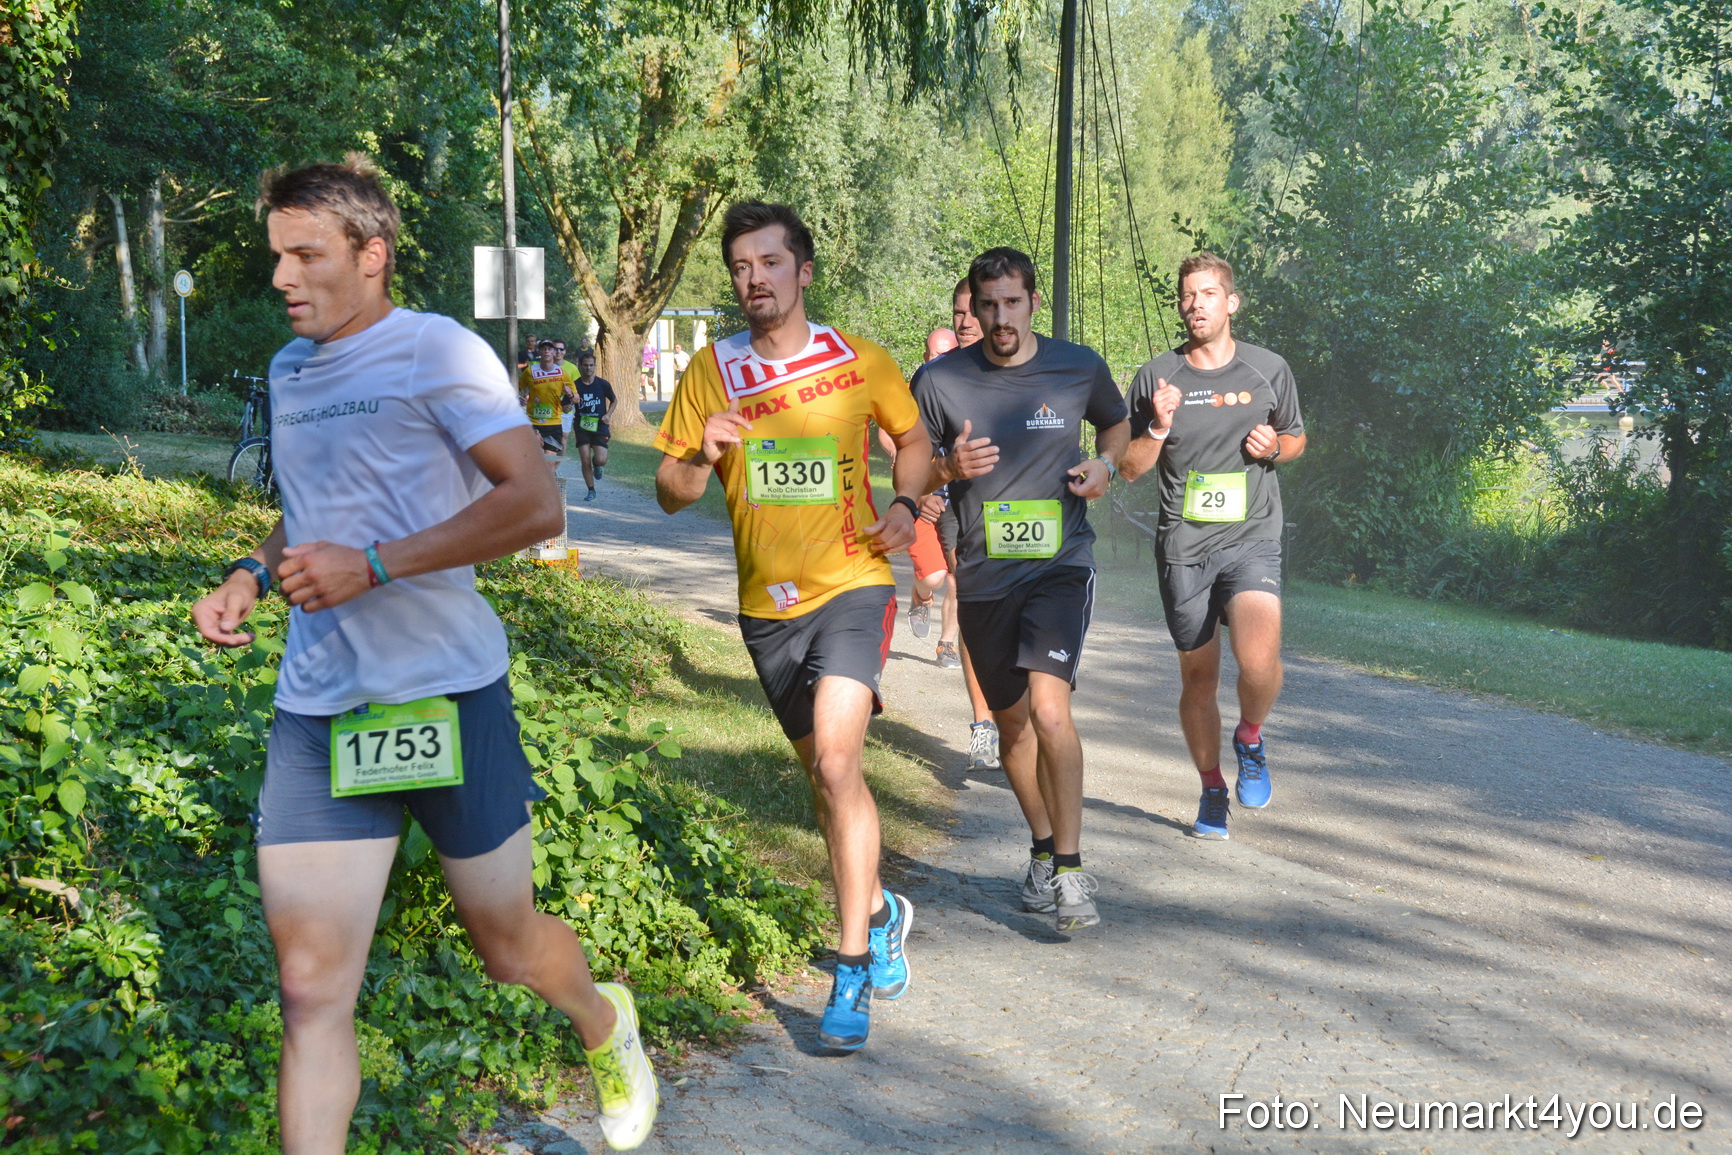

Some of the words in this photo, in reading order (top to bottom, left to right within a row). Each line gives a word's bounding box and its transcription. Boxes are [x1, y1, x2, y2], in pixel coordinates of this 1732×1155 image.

[797, 370, 865, 404] BÖGL
[583, 420, 595, 428] 295
[1026, 418, 1065, 427] BURKHARDT
[757, 461, 826, 486] 1330
[767, 486, 784, 494] Kolb
[785, 486, 818, 494] Christian
[1201, 491, 1226, 508] 29
[1001, 521, 1045, 542] 320
[998, 542, 1024, 550] Dollinger
[347, 726, 441, 766] 1753
[355, 764, 408, 777] Federhofer
[410, 762, 435, 772] Felix
